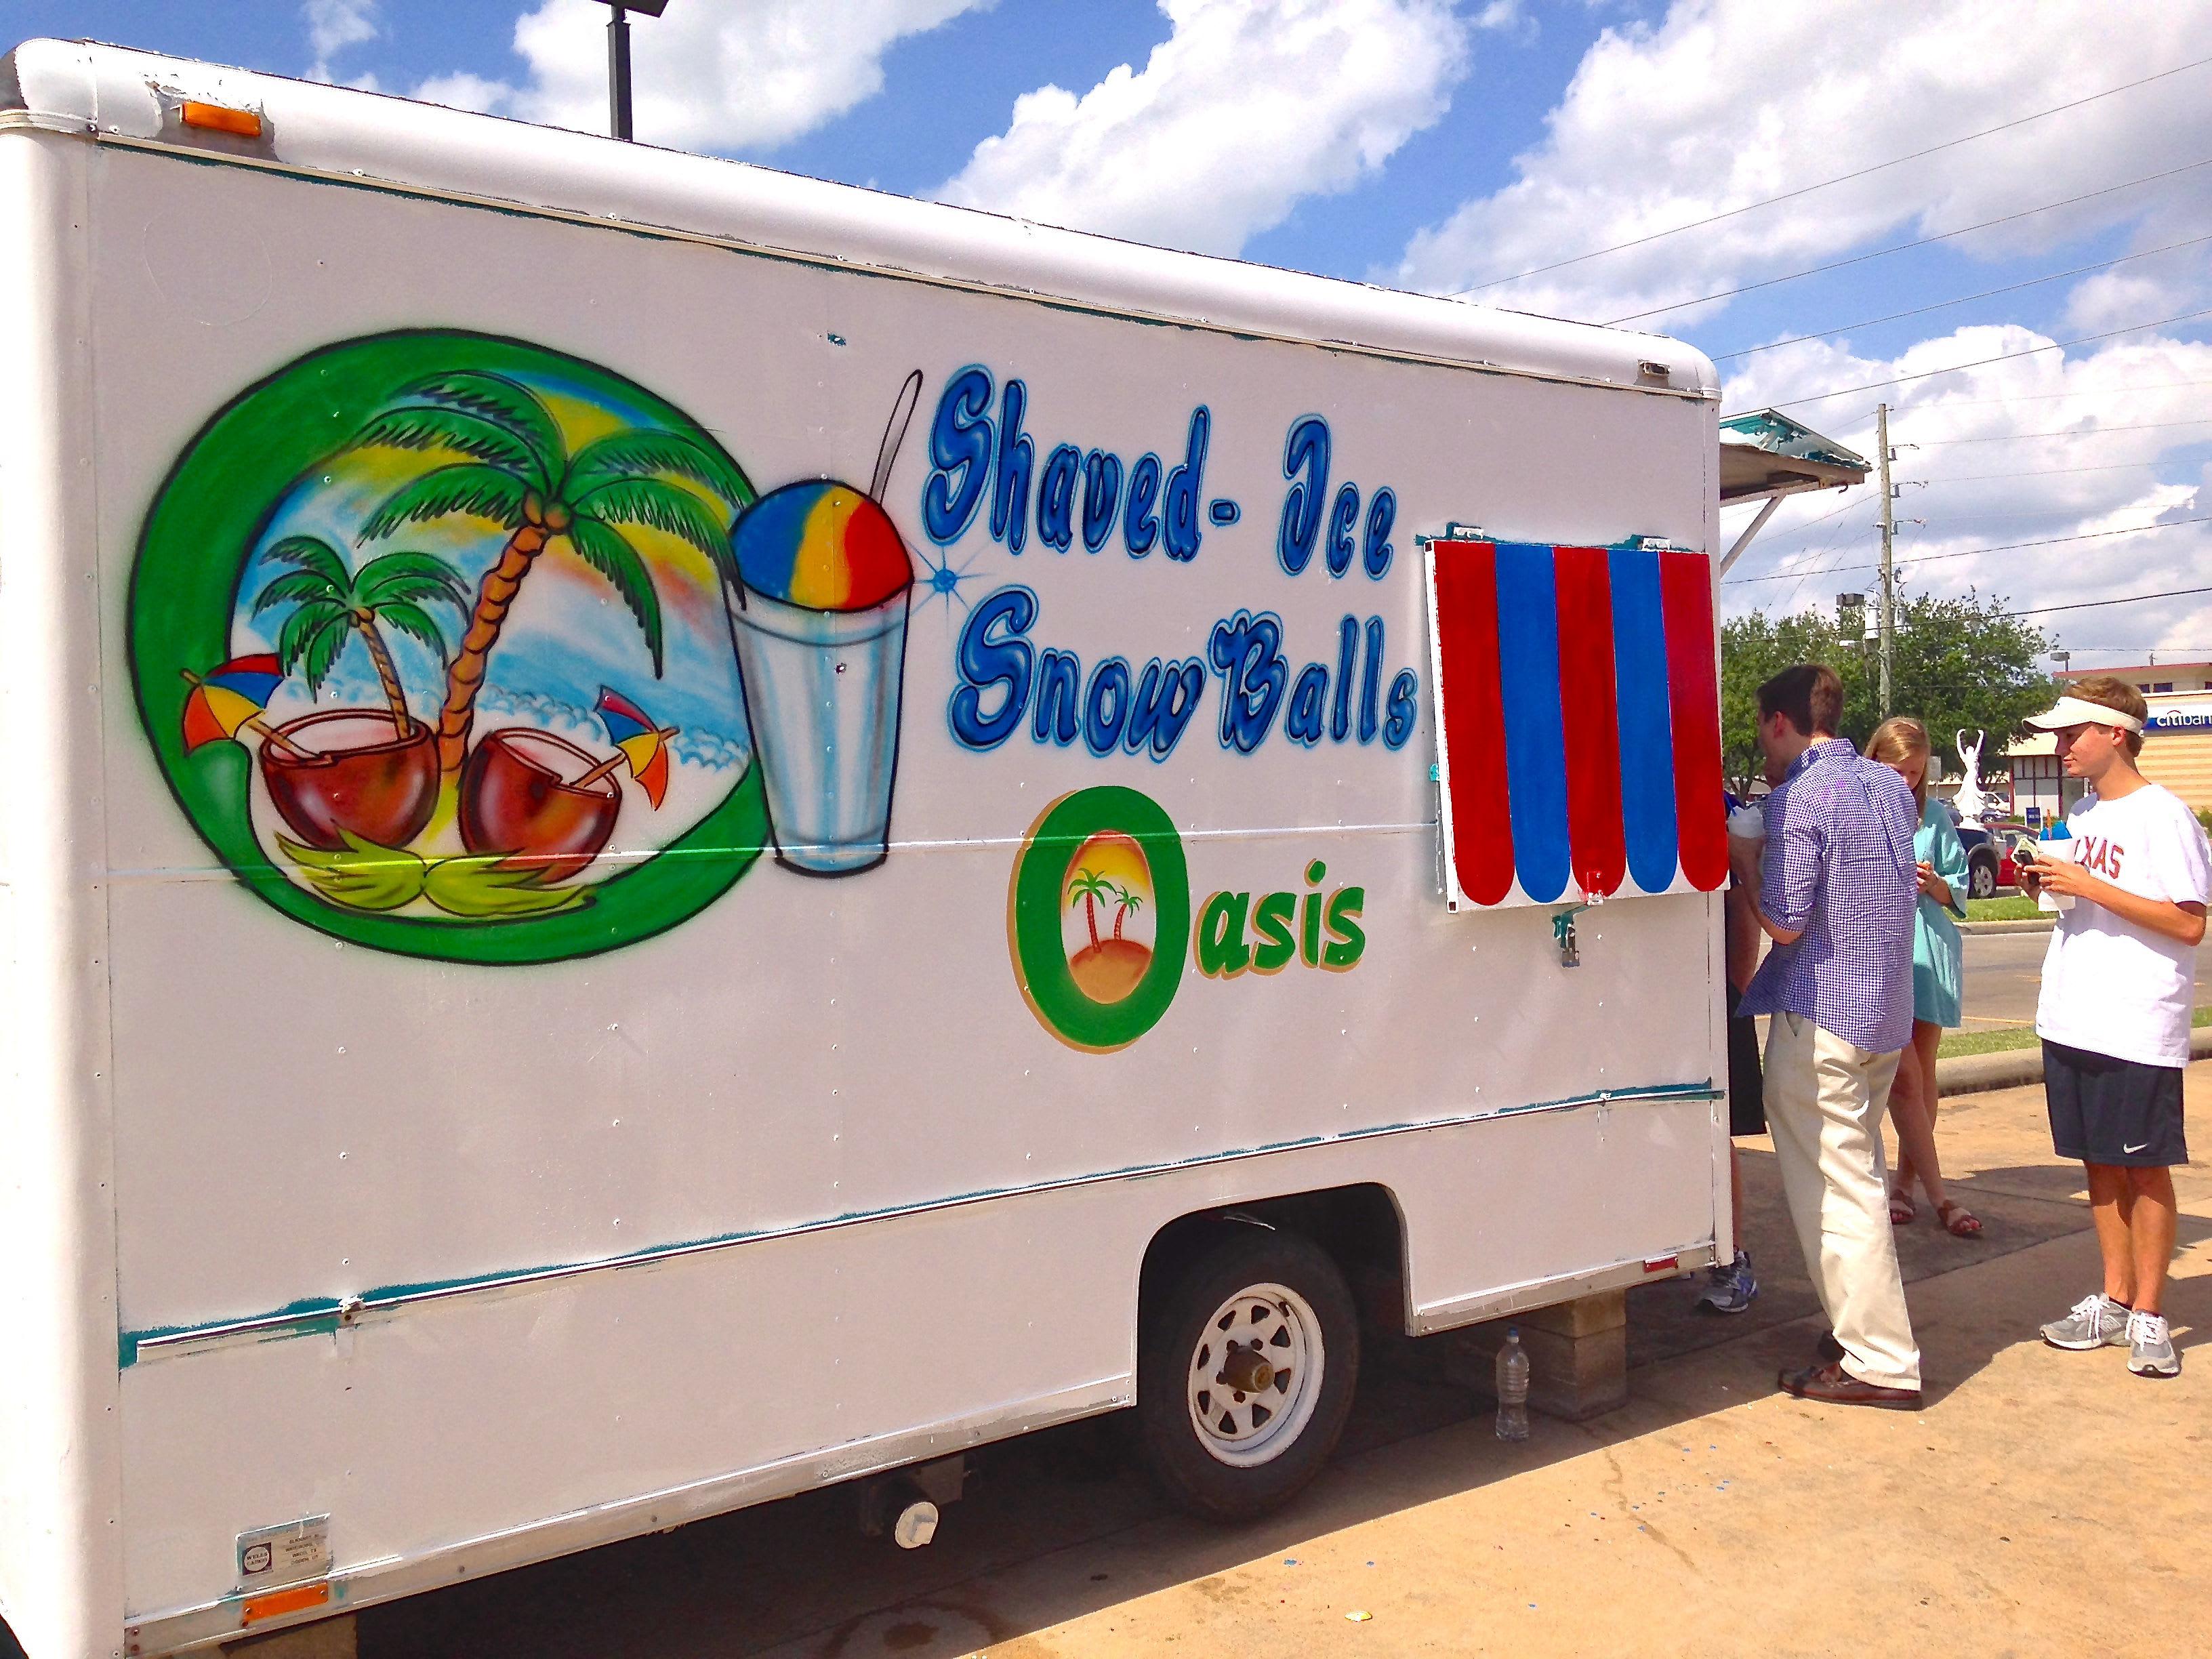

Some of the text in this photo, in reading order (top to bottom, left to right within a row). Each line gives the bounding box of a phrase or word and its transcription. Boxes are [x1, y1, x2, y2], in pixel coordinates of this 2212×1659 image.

[1279, 414, 1396, 581] Ice
[1006, 785, 1366, 1055] Oasis
[2074, 836, 2124, 879] XAS
